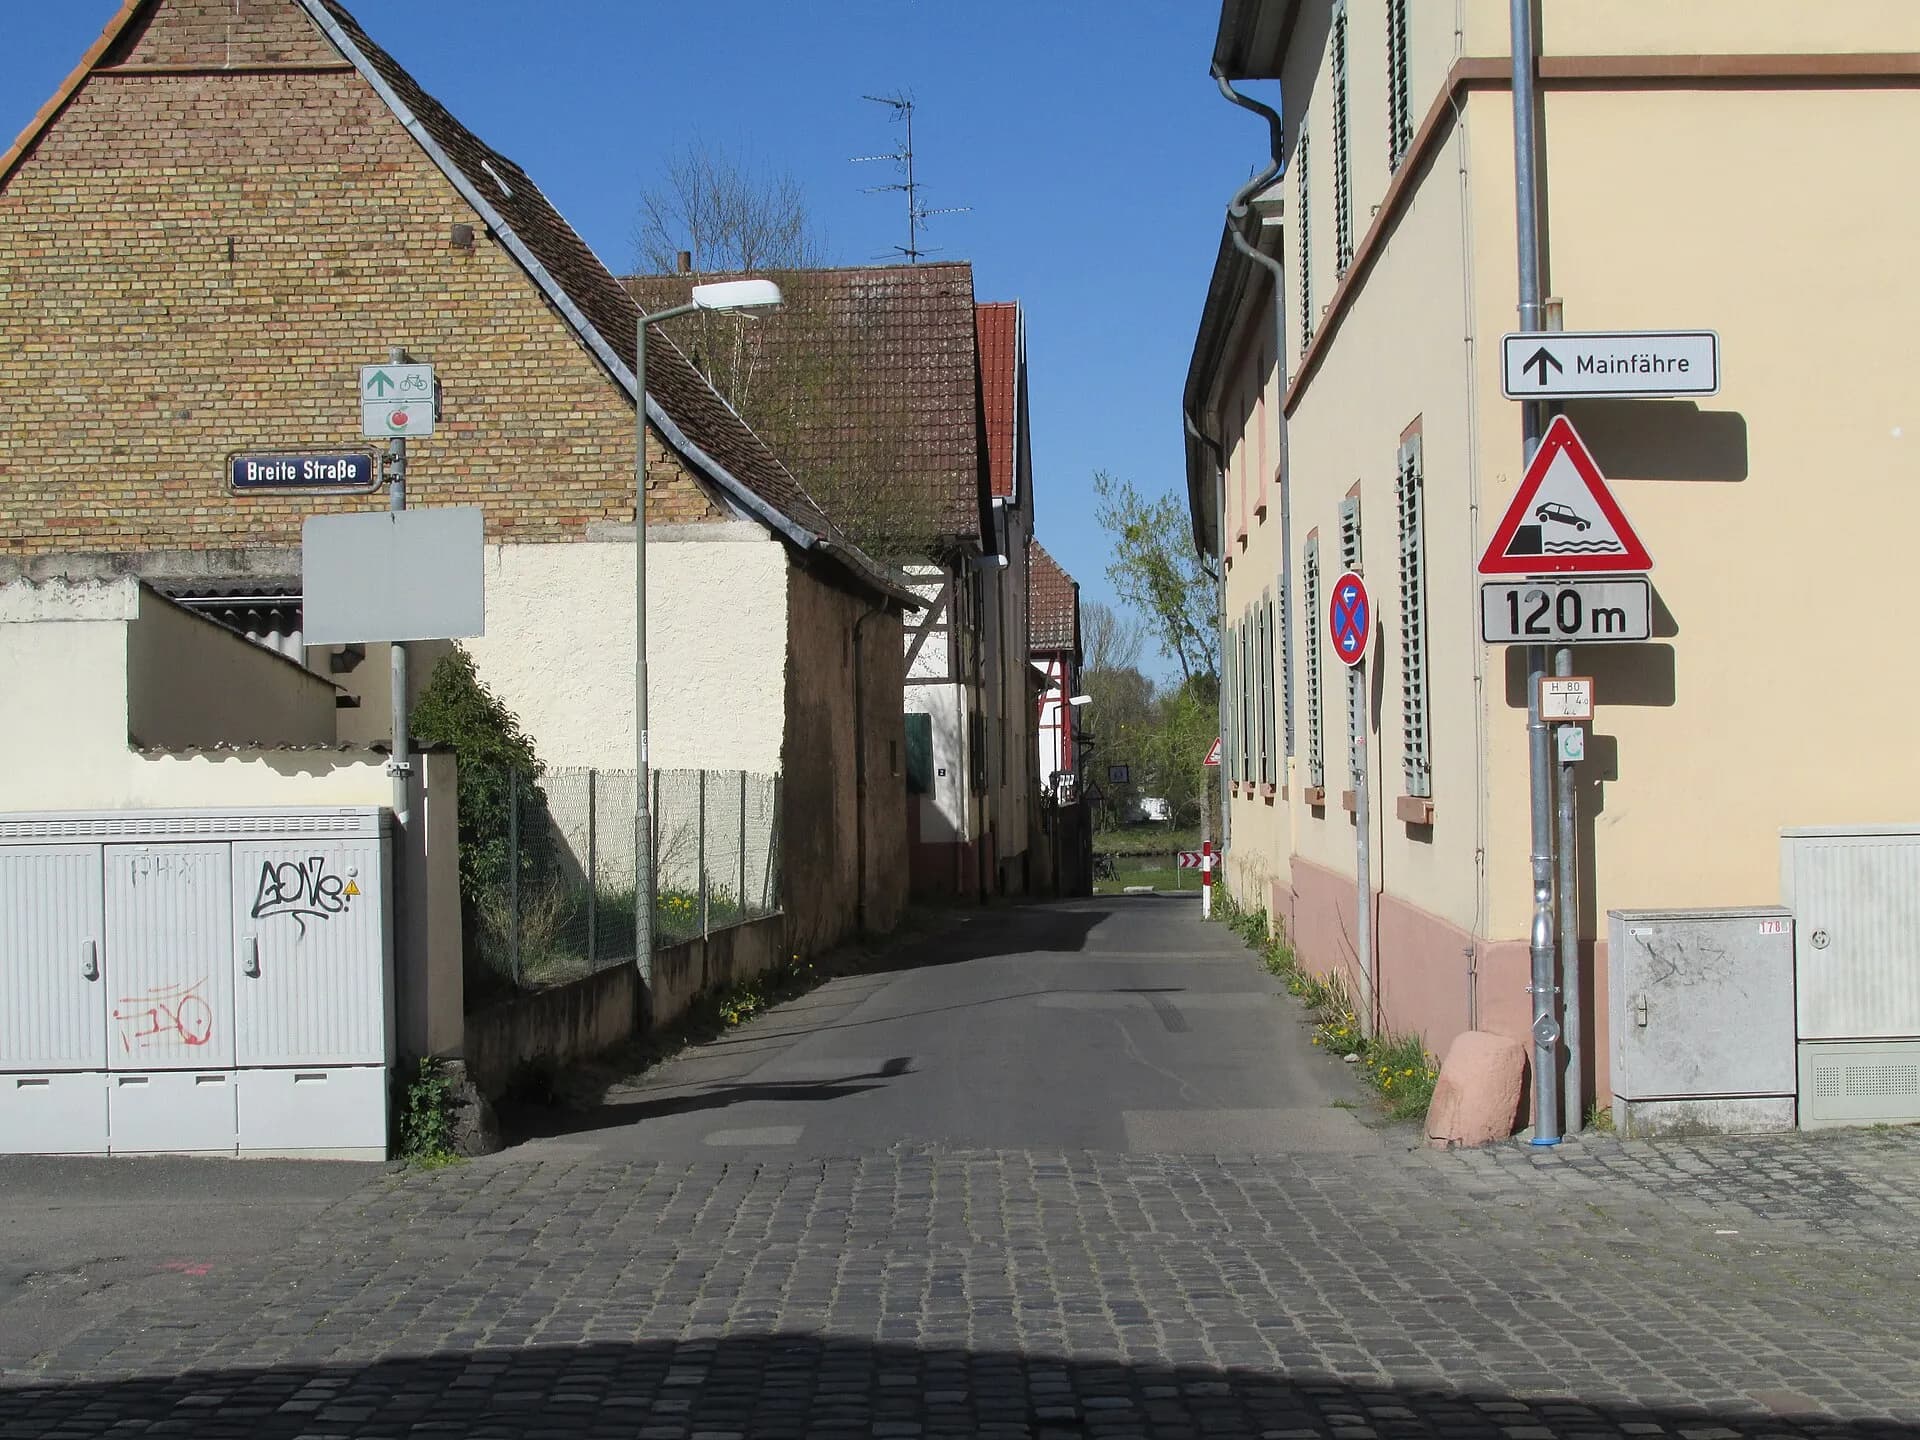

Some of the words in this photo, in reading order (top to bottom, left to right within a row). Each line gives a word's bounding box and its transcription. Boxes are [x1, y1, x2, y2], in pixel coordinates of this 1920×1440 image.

[1576, 354, 1690, 375] Mainfähre
[247, 461, 297, 481] Breite
[303, 460, 357, 481] Straße
[1506, 589, 1582, 635] 120
[1592, 607, 1626, 633] m
[1552, 682, 1559, 691] H
[1567, 682, 1580, 691] 80
[1761, 921, 1780, 932] 178
